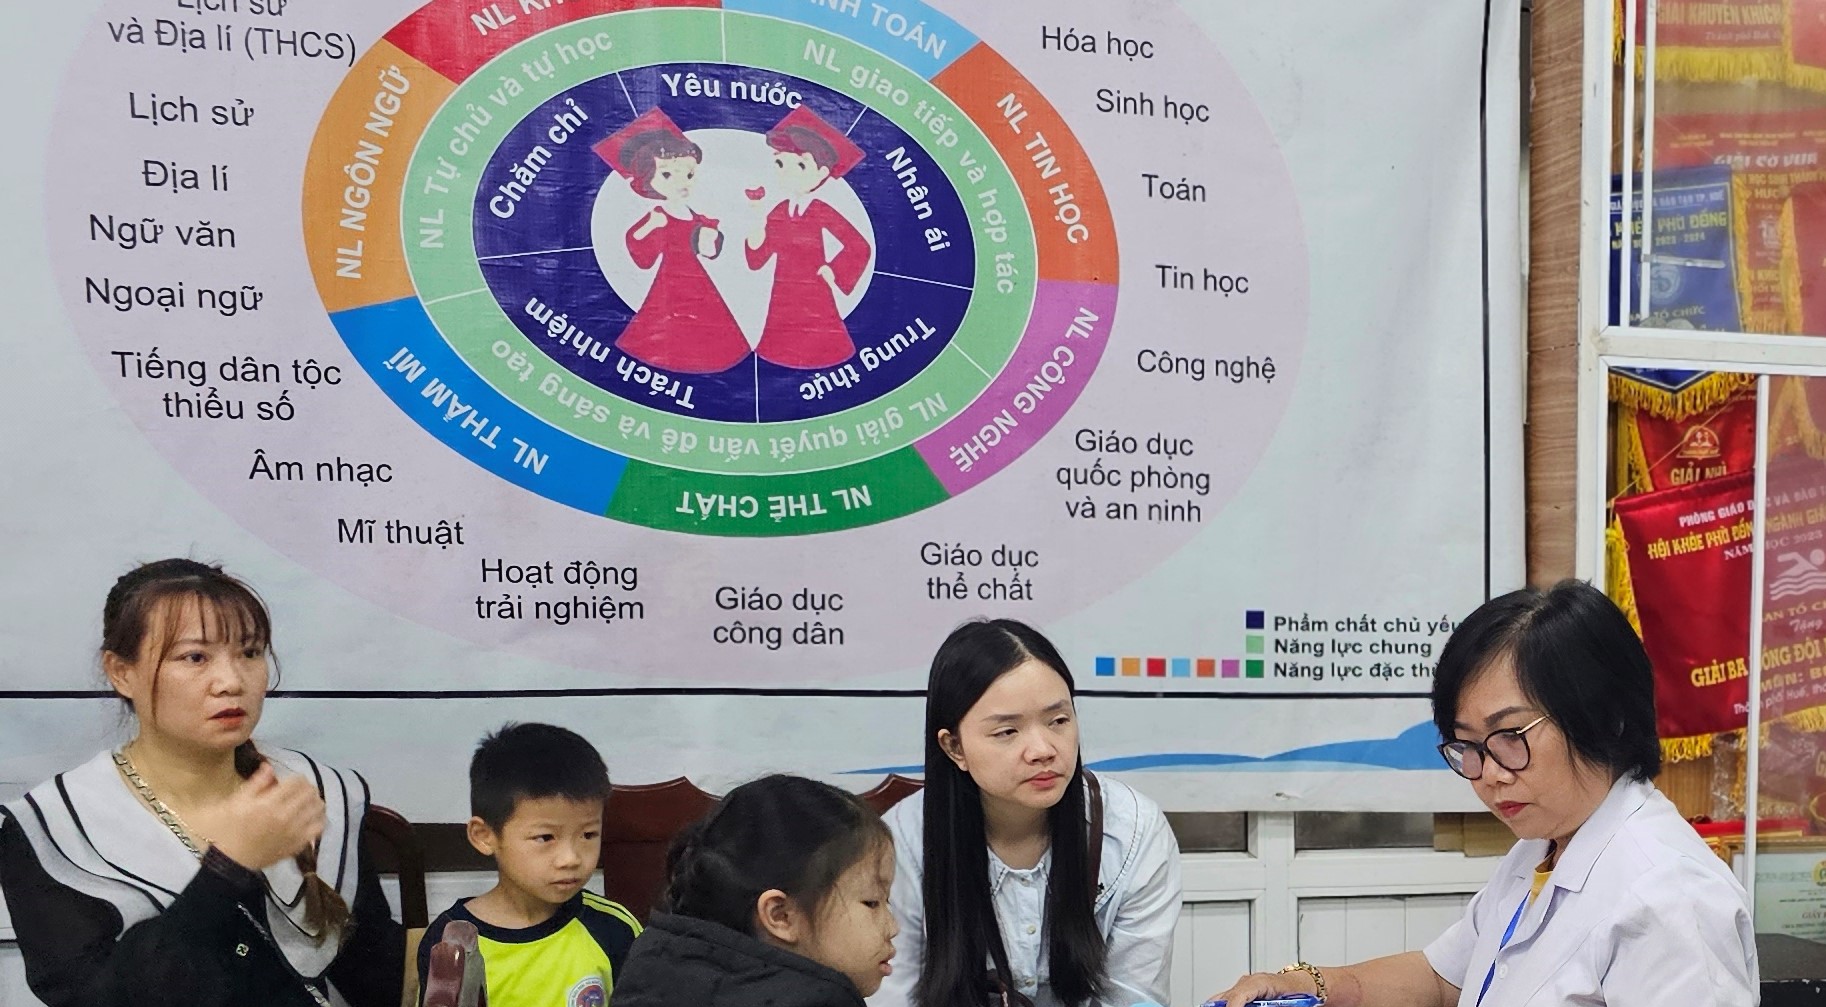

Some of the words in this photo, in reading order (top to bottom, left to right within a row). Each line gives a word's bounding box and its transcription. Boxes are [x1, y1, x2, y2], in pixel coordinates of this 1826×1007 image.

[470, 5, 516, 36] NL
[870, 7, 948, 58] TOÁN
[108, 18, 145, 44] và
[155, 19, 206, 53] Địa
[218, 25, 232, 52] lí
[245, 26, 356, 67] (THCS)
[555, 31, 614, 65] học
[1041, 26, 1099, 56] Hóa
[1107, 30, 1155, 62] học
[521, 50, 557, 83] tự
[364, 65, 411, 138] NGỮ
[489, 75, 525, 107] và
[662, 72, 722, 98] Yêu
[730, 80, 803, 111] nước
[1096, 89, 1155, 118] Sinh
[1163, 95, 1210, 126] học
[129, 92, 198, 126] Lịch
[211, 98, 255, 127] sử
[450, 103, 494, 157] chủ
[423, 156, 462, 195] Tự
[489, 145, 552, 219] Chăm
[548, 97, 590, 145] chỉ
[803, 39, 841, 73] NL
[850, 64, 910, 107] giao
[913, 98, 959, 149] tiếp
[959, 151, 988, 184] và
[978, 188, 1008, 244] hợp
[995, 251, 1020, 294] tác
[997, 93, 1028, 134] NL
[1025, 131, 1062, 180] TIN
[1049, 182, 1089, 244] HỌC
[141, 160, 200, 194] Địa
[211, 164, 229, 191] lí
[339, 139, 385, 232] NGÔN
[1141, 173, 1207, 203] Toán
[885, 146, 933, 220] Nhân
[924, 226, 951, 252] ái
[89, 214, 164, 250] Ngữ
[178, 217, 236, 249] văn
[419, 208, 445, 249] NL
[336, 239, 364, 280] NL
[86, 276, 187, 314] Ngoại
[197, 284, 264, 316] ngữ
[1156, 265, 1194, 291] Tin
[1202, 268, 1250, 298] học
[524, 297, 611, 363] nhiệm
[1064, 307, 1099, 339] NL
[491, 339, 536, 383] tạo
[858, 317, 937, 372] Trung
[111, 346, 208, 386] Tiếng
[218, 354, 281, 385] dân
[291, 358, 342, 387] tộc
[382, 346, 427, 384] MĨ
[615, 355, 696, 410] Trách
[800, 365, 861, 401] thực
[1013, 345, 1075, 414] CÔNG
[1137, 348, 1204, 379] Công
[1213, 355, 1277, 383] nghệ
[163, 387, 244, 421] thiểu
[256, 387, 295, 421] số
[420, 377, 502, 450] THẨM
[538, 372, 611, 424] sáng
[909, 392, 948, 422] NL
[617, 413, 651, 440] và
[661, 428, 699, 454] đề
[769, 425, 848, 463] quyết
[855, 406, 905, 447] giải
[949, 408, 1019, 473] NGHỆ
[1075, 428, 1138, 456] Giáo
[1146, 429, 1194, 461] dục
[512, 437, 550, 475] NL
[708, 435, 761, 463] vấn
[248, 448, 304, 481] Âm
[316, 455, 393, 487] nhạc
[1056, 457, 1121, 491] quốc
[1130, 463, 1211, 496] phòng
[675, 491, 759, 521] CHẤT
[767, 493, 828, 523] THỂ
[832, 485, 873, 510] NL
[1066, 495, 1098, 519] và
[1106, 501, 1138, 520] an
[1147, 501, 1202, 523] ninh
[338, 517, 375, 543] Mĩ
[385, 516, 465, 548] thuật
[920, 541, 983, 567] Giáo
[990, 543, 1039, 570] dục
[481, 559, 553, 588] Hoạt
[563, 560, 639, 590] động
[927, 570, 969, 601] thể
[976, 570, 1034, 604] chất
[475, 591, 523, 620] trải
[535, 595, 645, 626] nghiệm
[715, 585, 783, 612] Giáo
[792, 587, 844, 615] dục
[713, 621, 782, 647] công
[792, 619, 845, 646] dân
[1274, 612, 1329, 633] Phẩm
[1335, 613, 1378, 634] chất
[1384, 615, 1421, 634] chủ
[1274, 637, 1324, 658] Năng
[1331, 637, 1361, 657] lực
[1368, 638, 1432, 658] chung
[1274, 660, 1324, 681] Năng
[1331, 660, 1363, 681] lực
[1370, 660, 1405, 682] đặc
